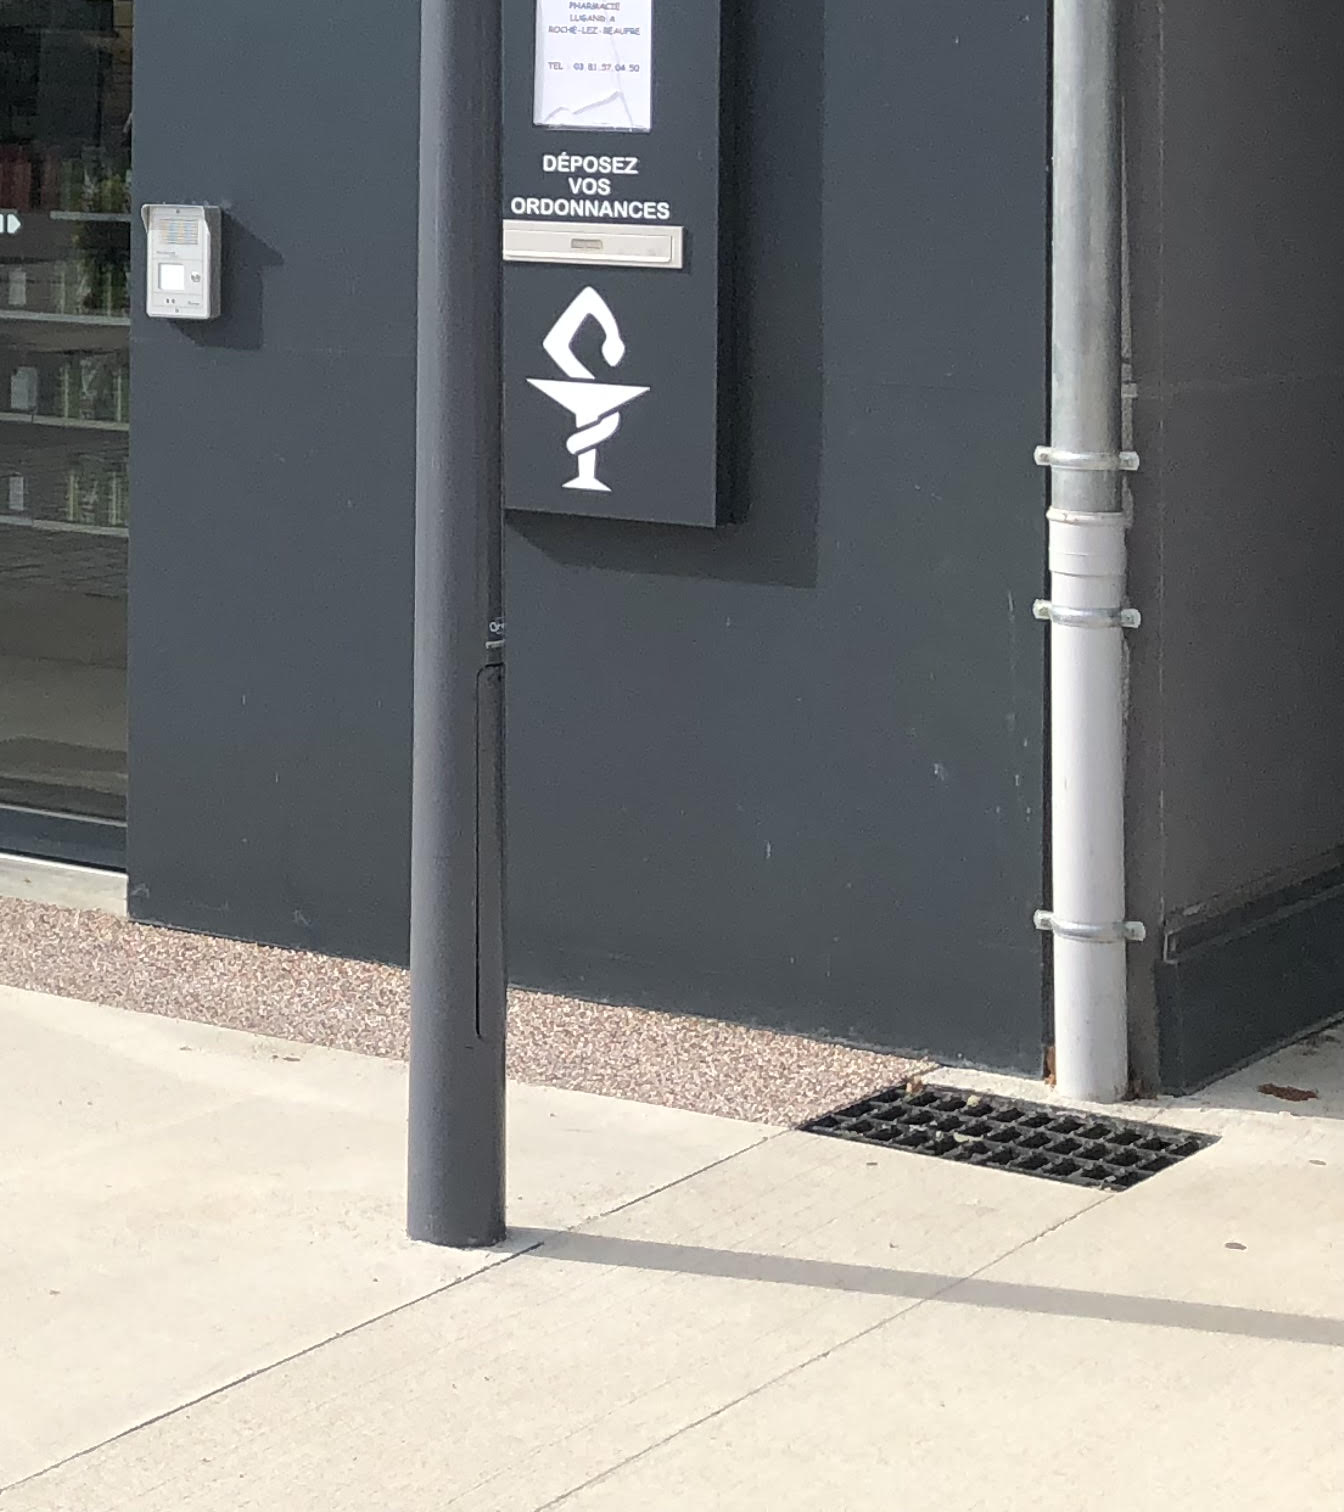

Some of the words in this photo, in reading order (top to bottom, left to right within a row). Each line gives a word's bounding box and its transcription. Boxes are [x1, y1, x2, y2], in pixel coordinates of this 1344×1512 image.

[543, 151, 638, 174] DÉPOSEZ
[568, 177, 611, 195] VOS
[510, 197, 670, 219] ORDONNANCES
